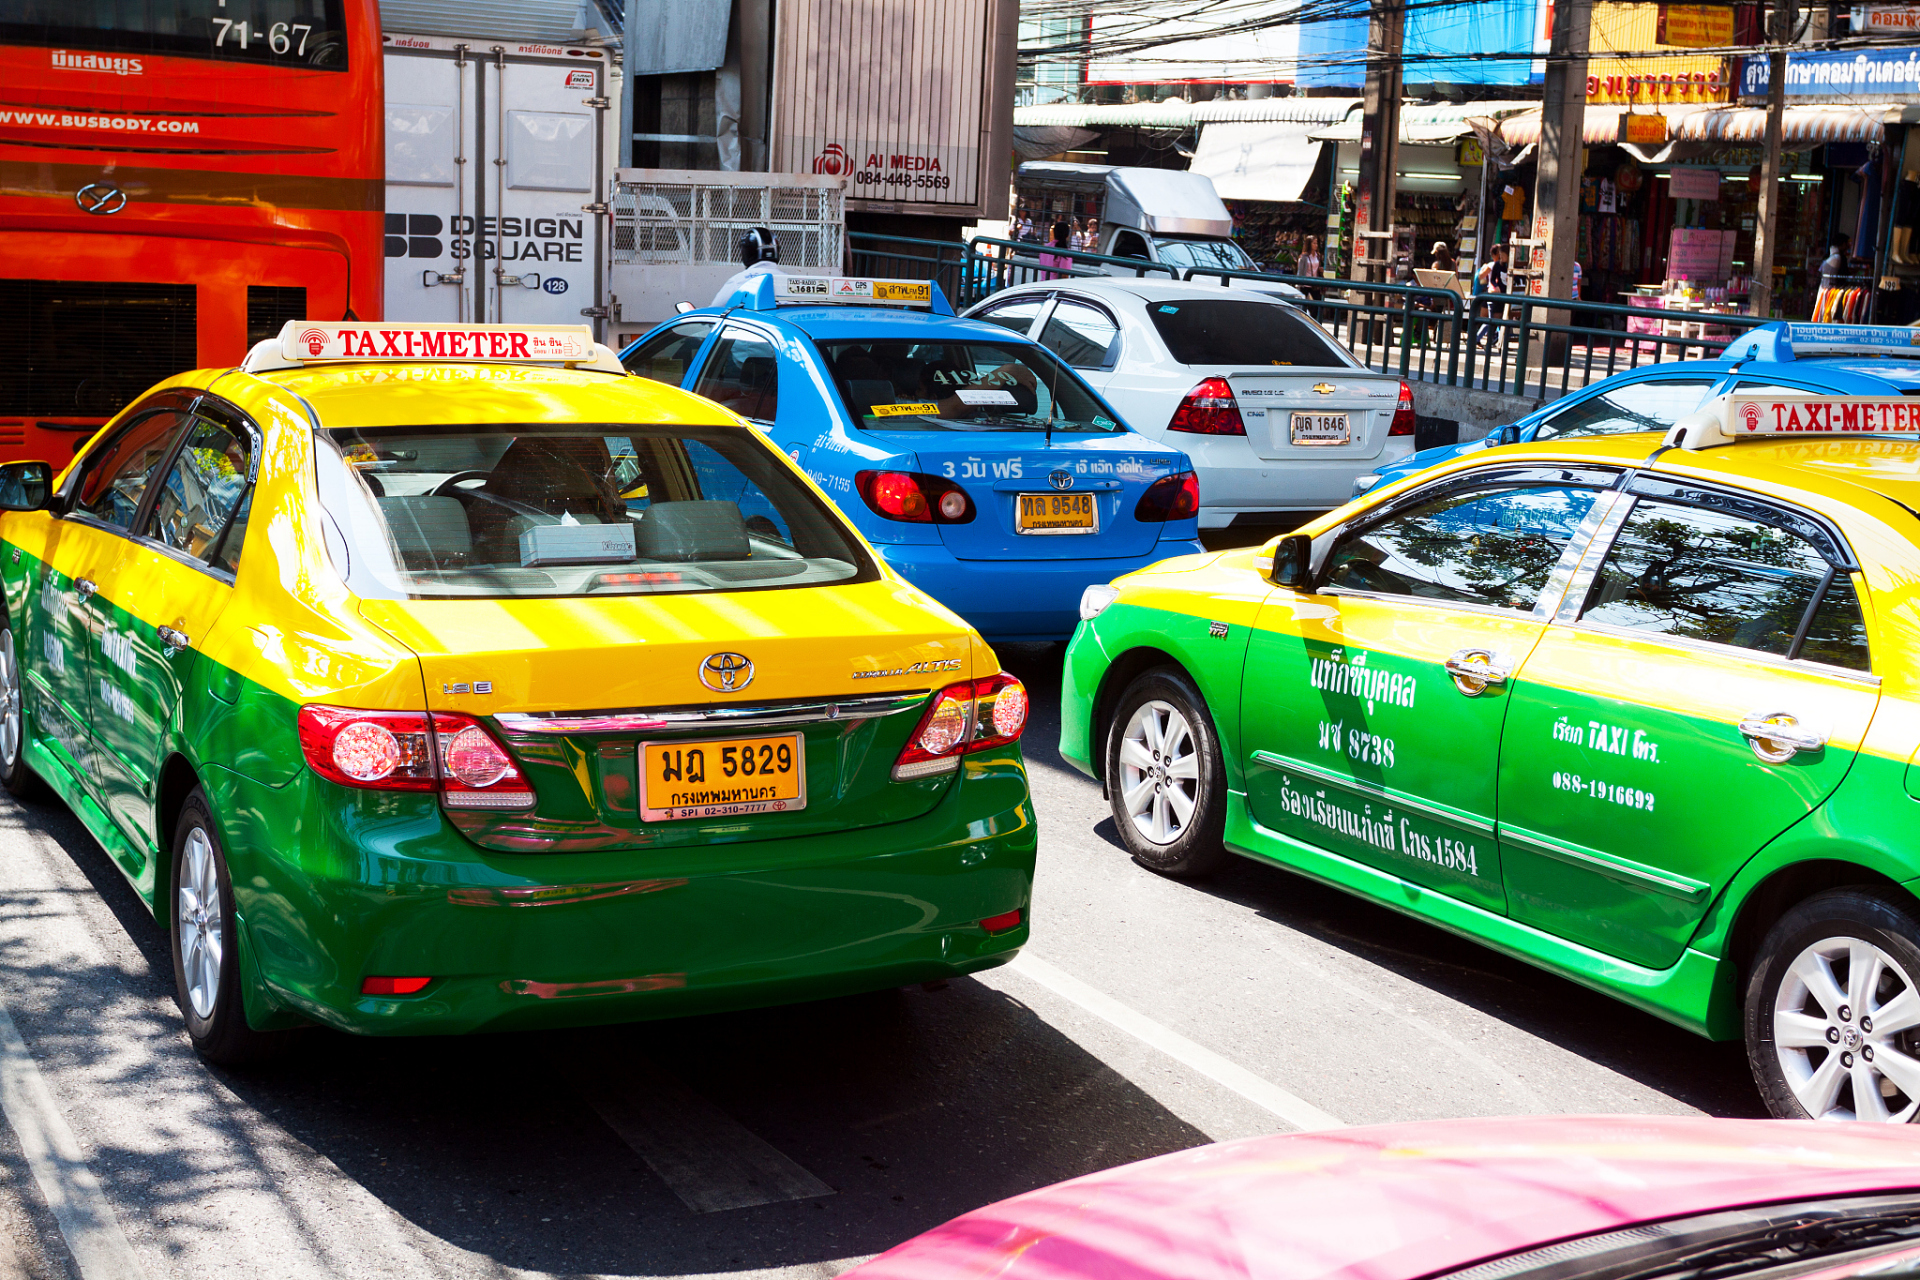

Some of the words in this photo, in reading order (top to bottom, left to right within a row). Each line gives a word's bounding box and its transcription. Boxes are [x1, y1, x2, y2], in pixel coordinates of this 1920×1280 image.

[1872, 9, 1920, 27] คอมพิ
[212, 17, 312, 57] 71-67
[0, 111, 200, 134] WWW.BUSBODY.COM
[866, 154, 883, 168] AI
[890, 155, 941, 172] MEDIA
[856, 171, 950, 189] 084-448-5569
[450, 215, 583, 239] DESIGN
[450, 239, 583, 262] SQUARE
[546, 281, 565, 292] 128
[855, 281, 867, 289] GPS
[337, 330, 531, 357] TAXI-METER
[1317, 416, 1344, 431] 1646
[1771, 403, 1920, 432] TAXI-METER
[942, 461, 956, 478] 3
[961, 456, 986, 478] วัน
[991, 456, 1023, 479] ฟรี
[1116, 456, 1144, 474] จัดให้
[1022, 497, 1046, 516] ทล
[1052, 496, 1090, 515] 9548
[904, 658, 962, 675] ALTIS
[1349, 729, 1395, 768] 8738
[1553, 715, 1583, 746] เรียก
[1588, 720, 1629, 756] TAXI
[1633, 729, 1660, 764] โทร.
[722, 743, 791, 777] 5829
[1552, 771, 1655, 812] 088-1916692
[681, 808, 698, 817] SPI
[704, 803, 767, 816] 02-310-7777
